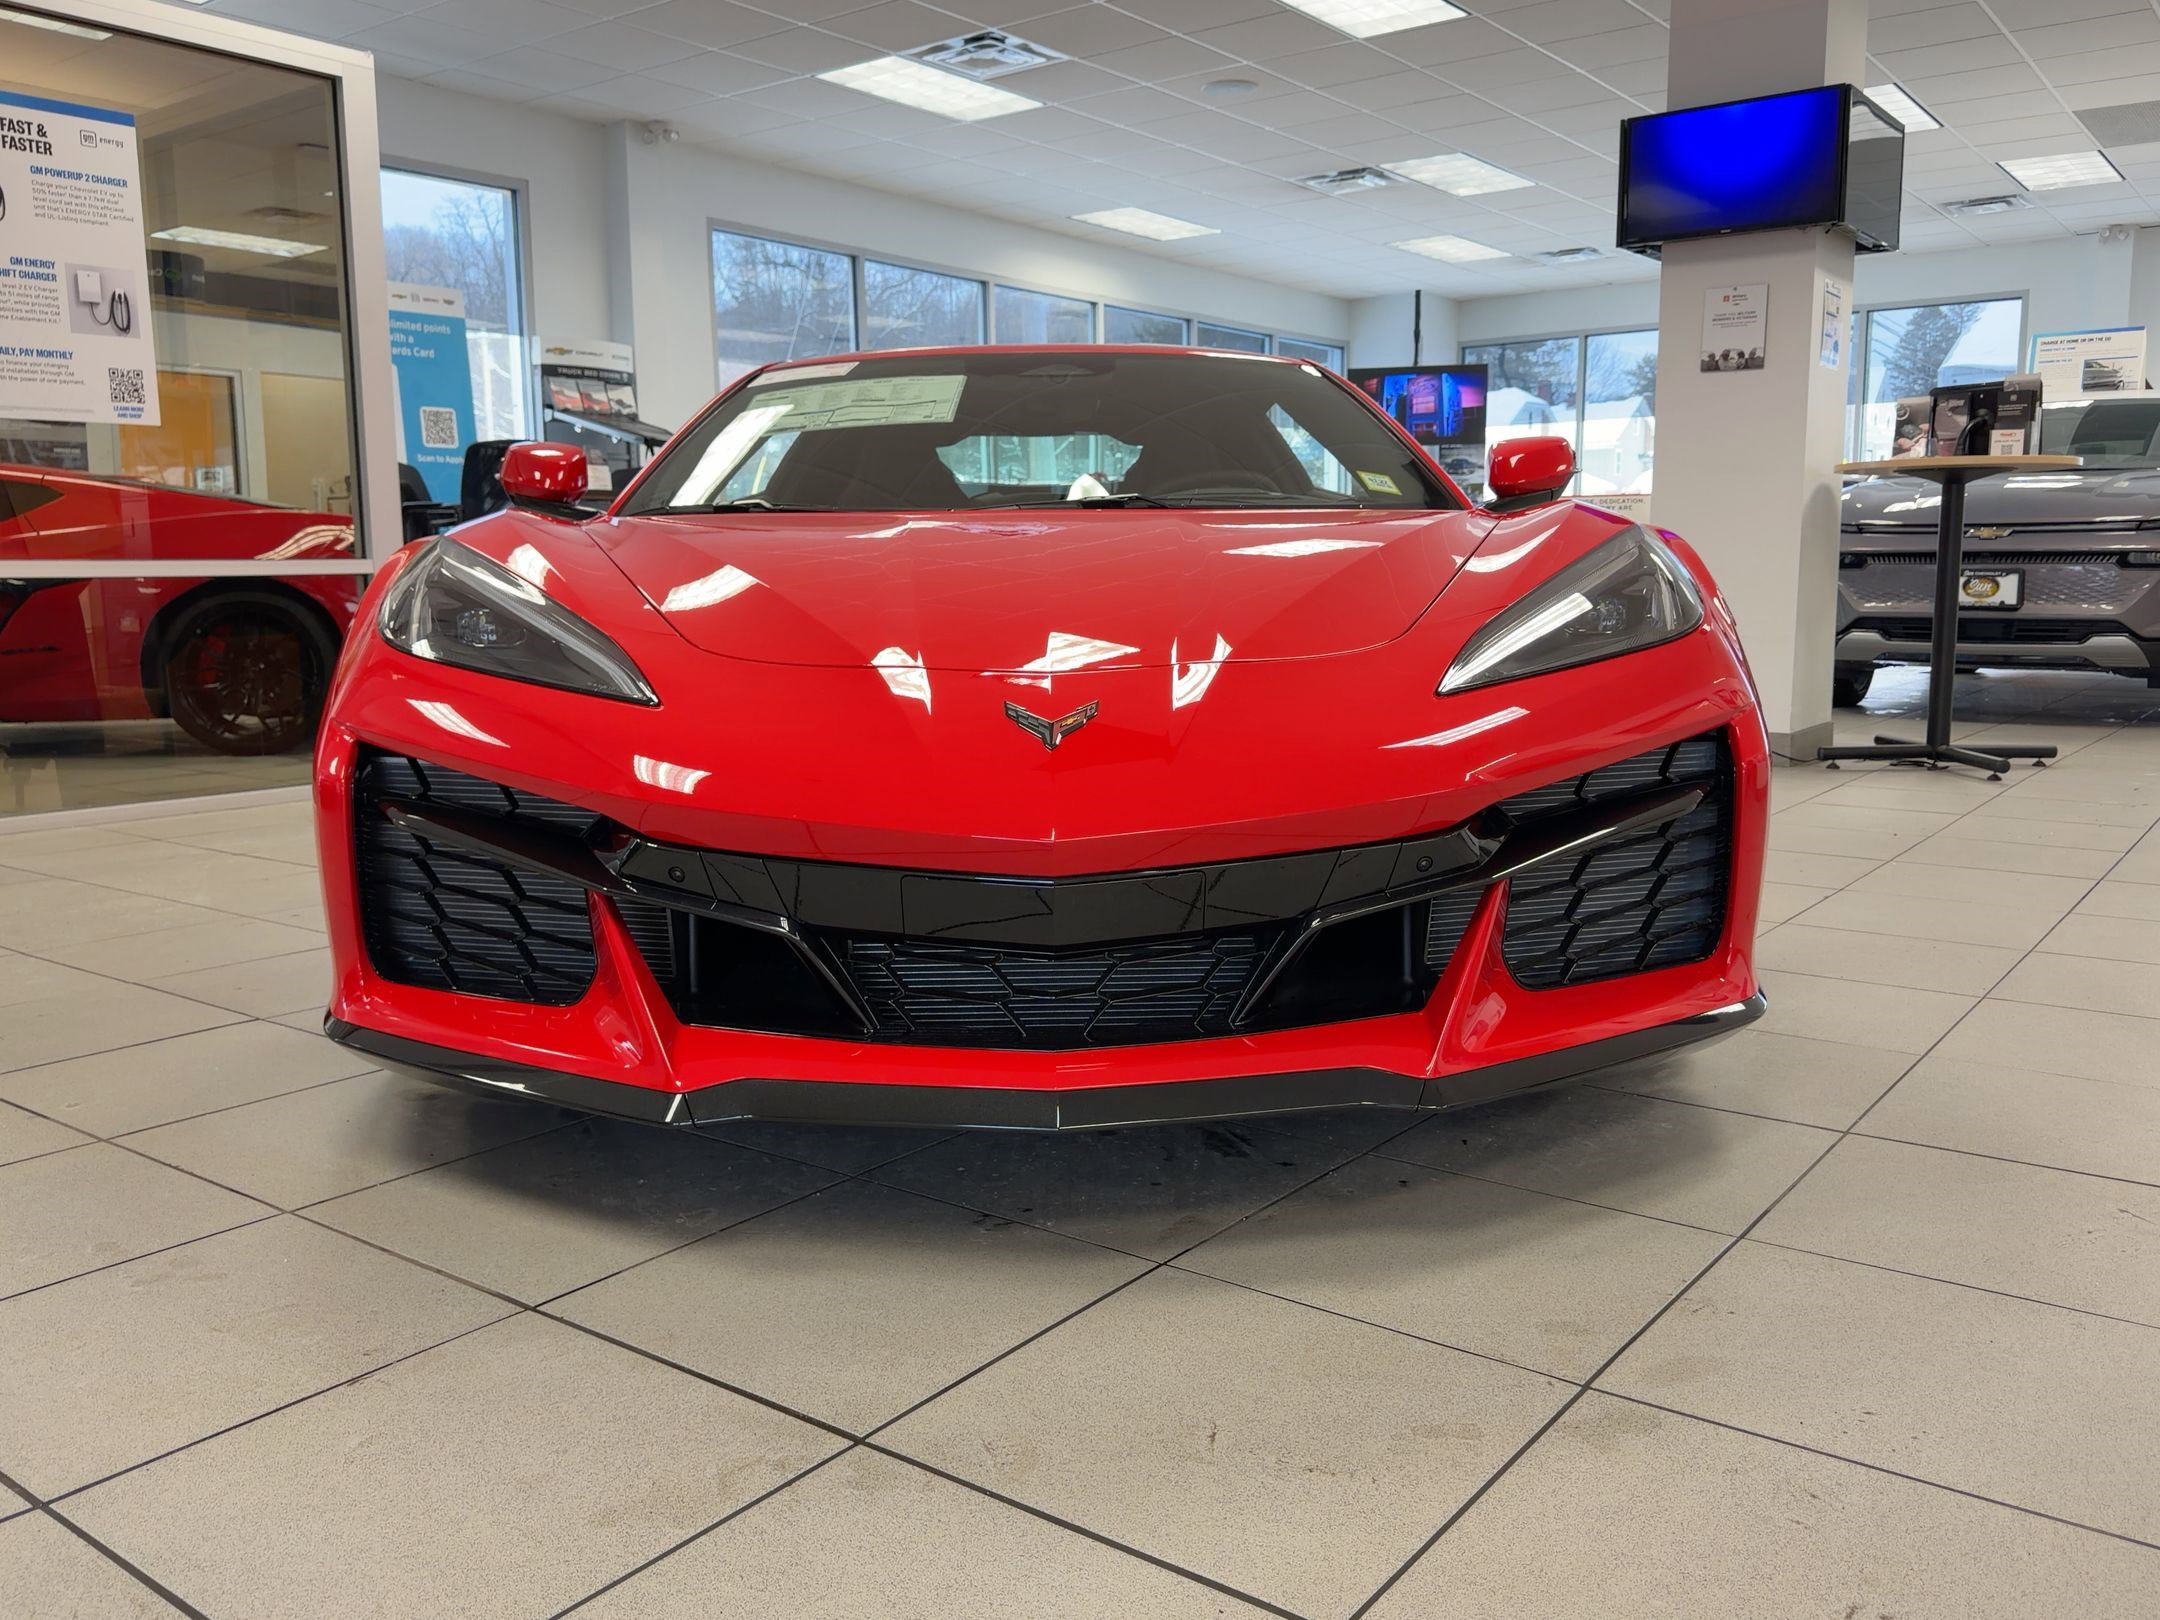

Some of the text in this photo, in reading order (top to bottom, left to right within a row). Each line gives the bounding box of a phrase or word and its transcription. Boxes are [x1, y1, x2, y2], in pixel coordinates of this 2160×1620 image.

[0, 117, 48, 139] FAST &
[1, 134, 53, 156] FASTER
[99, 138, 124, 149] energy
[30, 165, 128, 188] GM POWERUP 2 CHARGER
[10, 256, 55, 270] GM ENERGY
[19, 270, 57, 282] CHARGER
[423, 323, 451, 335] points
[408, 335, 414, 343] a
[19, 347, 34, 358] PAY
[36, 349, 73, 361] MONTHLY
[413, 347, 435, 359] Card
